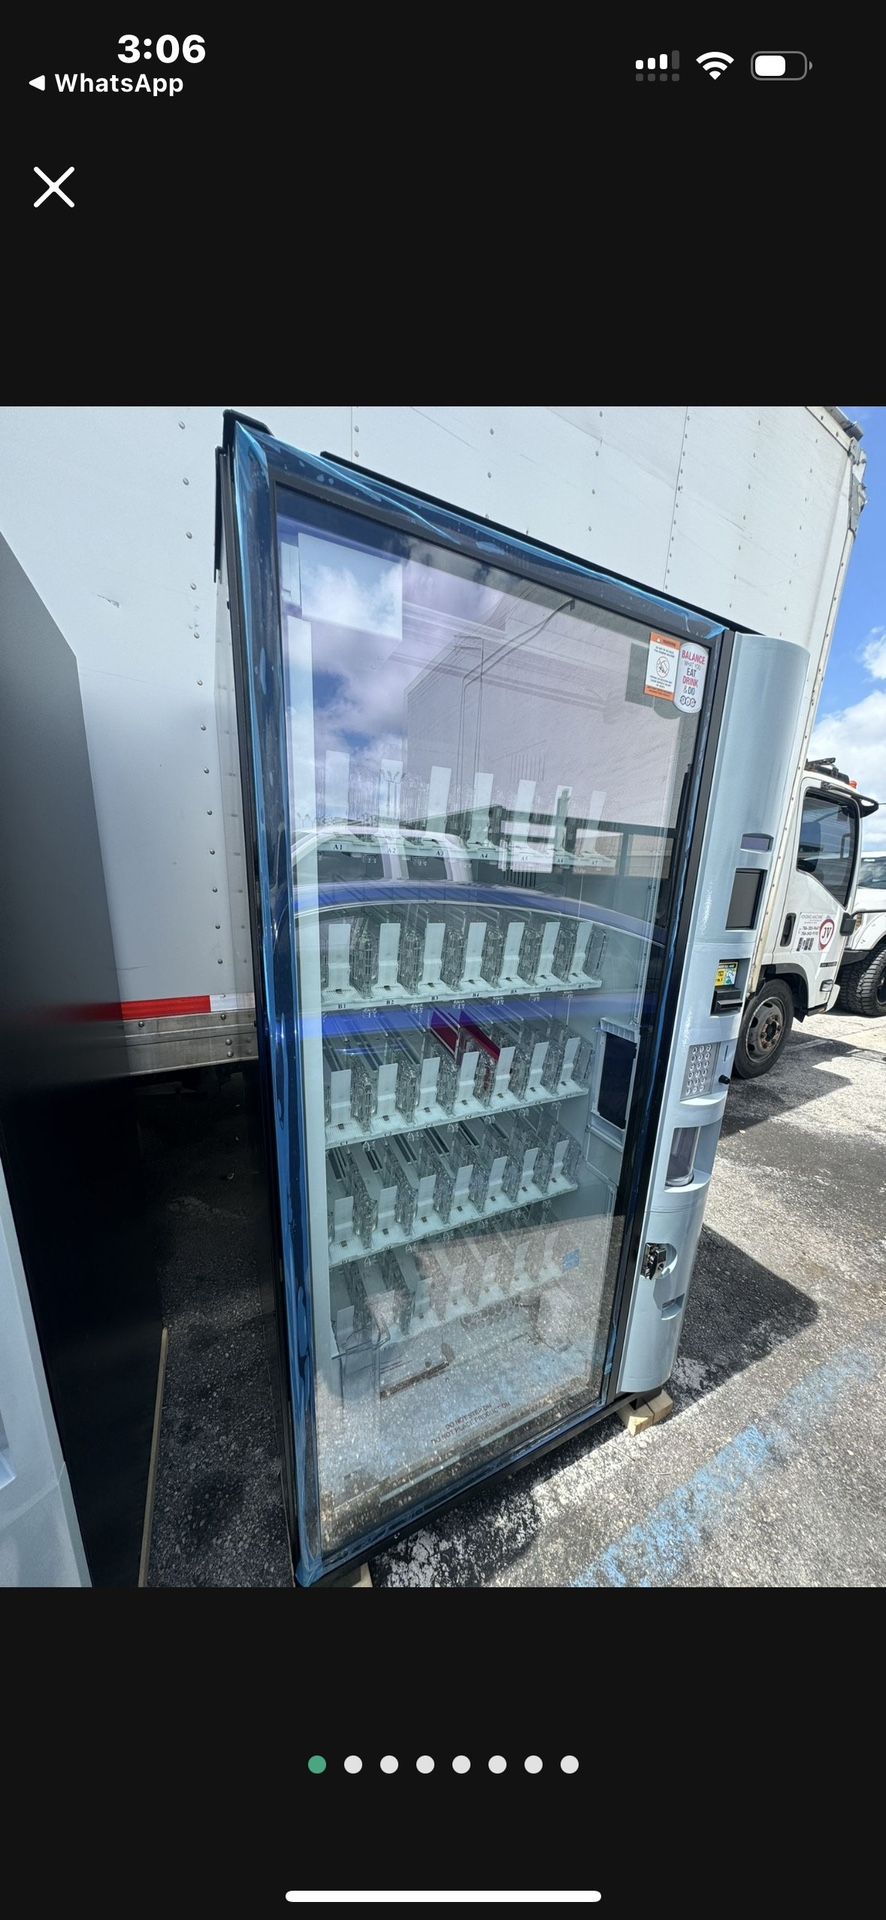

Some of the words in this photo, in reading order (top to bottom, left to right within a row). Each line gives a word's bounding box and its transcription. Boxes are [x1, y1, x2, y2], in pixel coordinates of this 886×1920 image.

[681, 650, 706, 665] BALANCE
[686, 667, 697, 677] EAT
[682, 676, 699, 687] DRINK
[688, 687, 696, 696] DO
[456, 1414, 468, 1424] NOT
